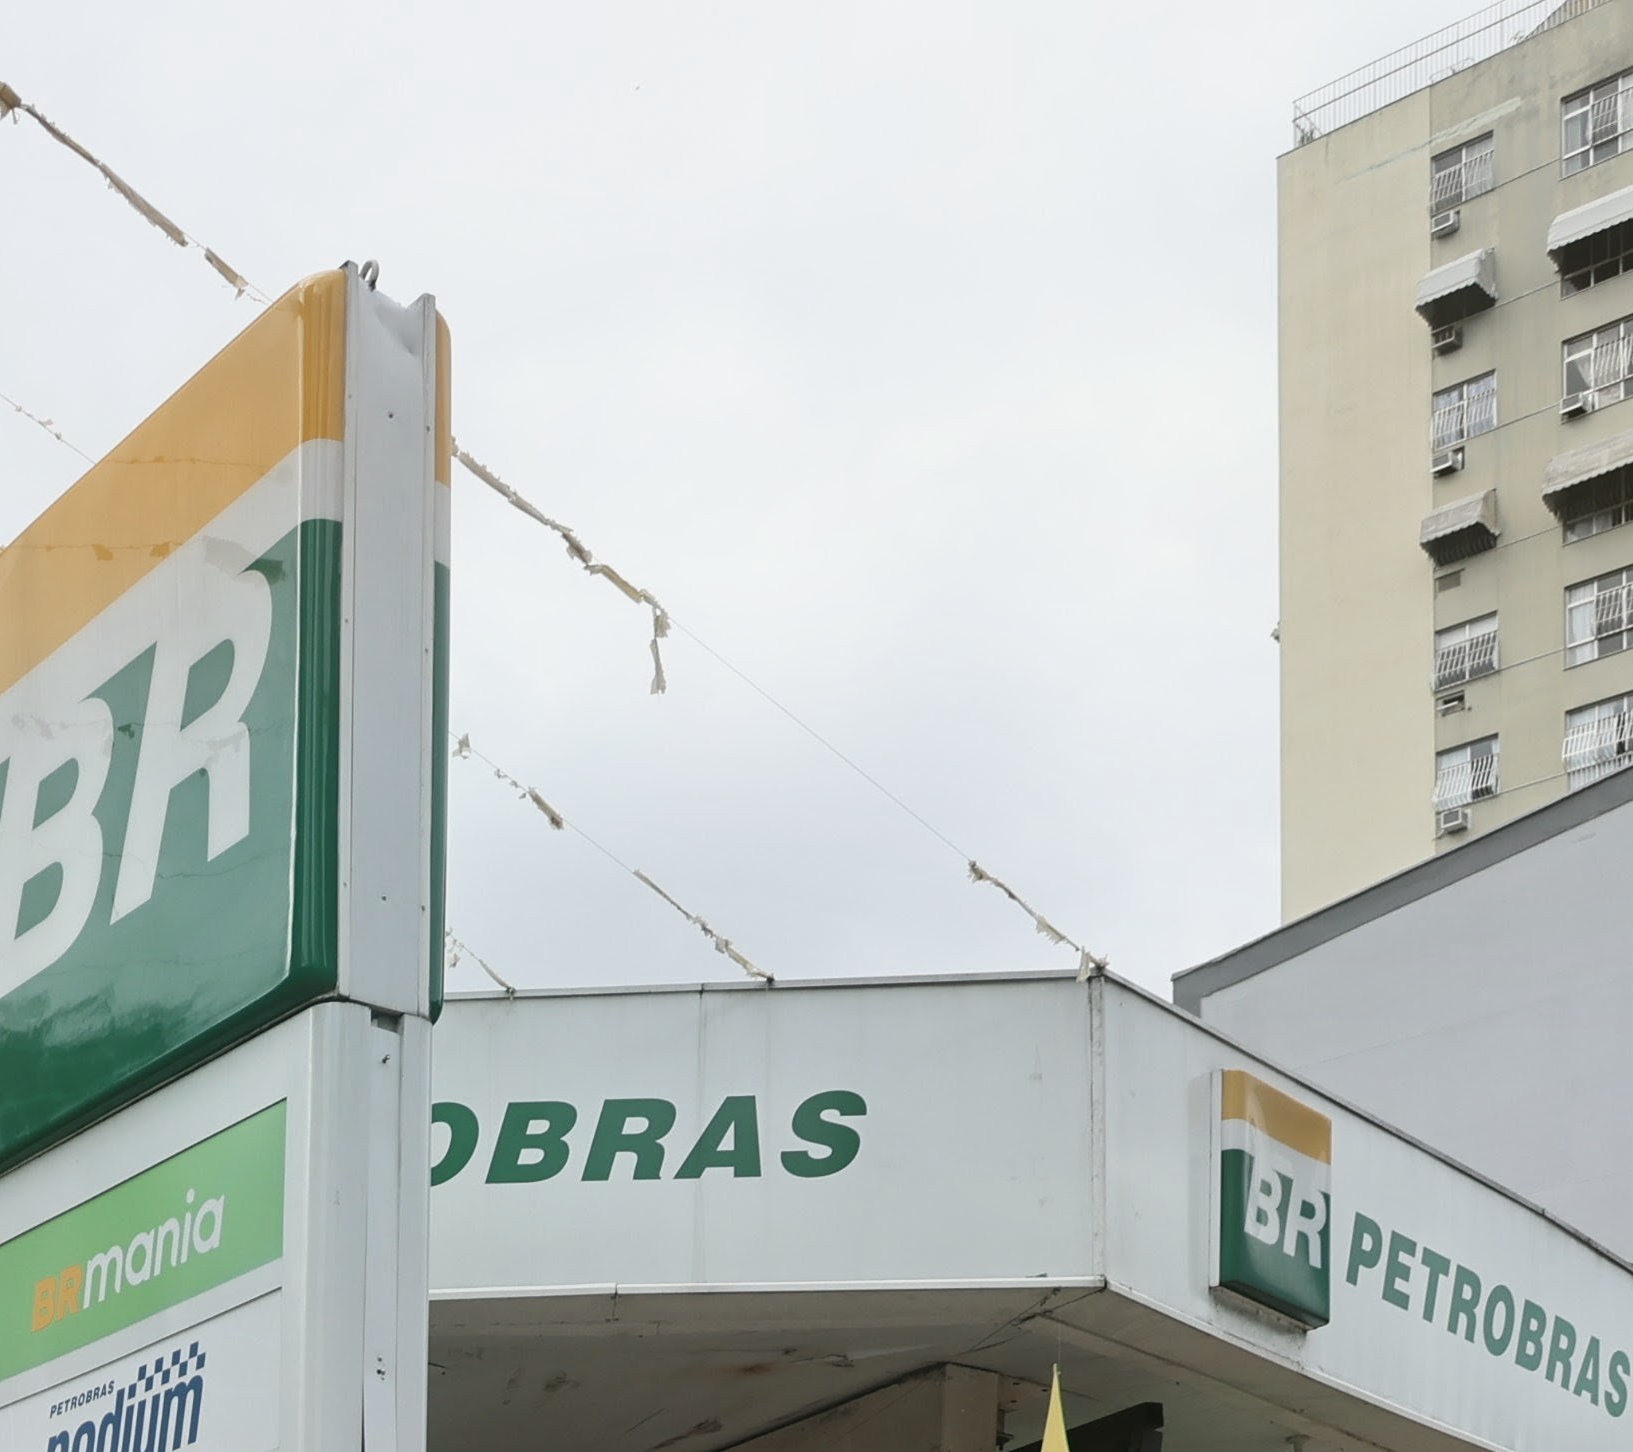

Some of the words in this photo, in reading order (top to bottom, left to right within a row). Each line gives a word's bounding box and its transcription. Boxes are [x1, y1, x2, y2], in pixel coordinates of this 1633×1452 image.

[1244, 1153, 1326, 1269] BR
[1346, 1211, 1630, 1417] PETROBRAS
[49, 1381, 115, 1419] PETROBRAS
